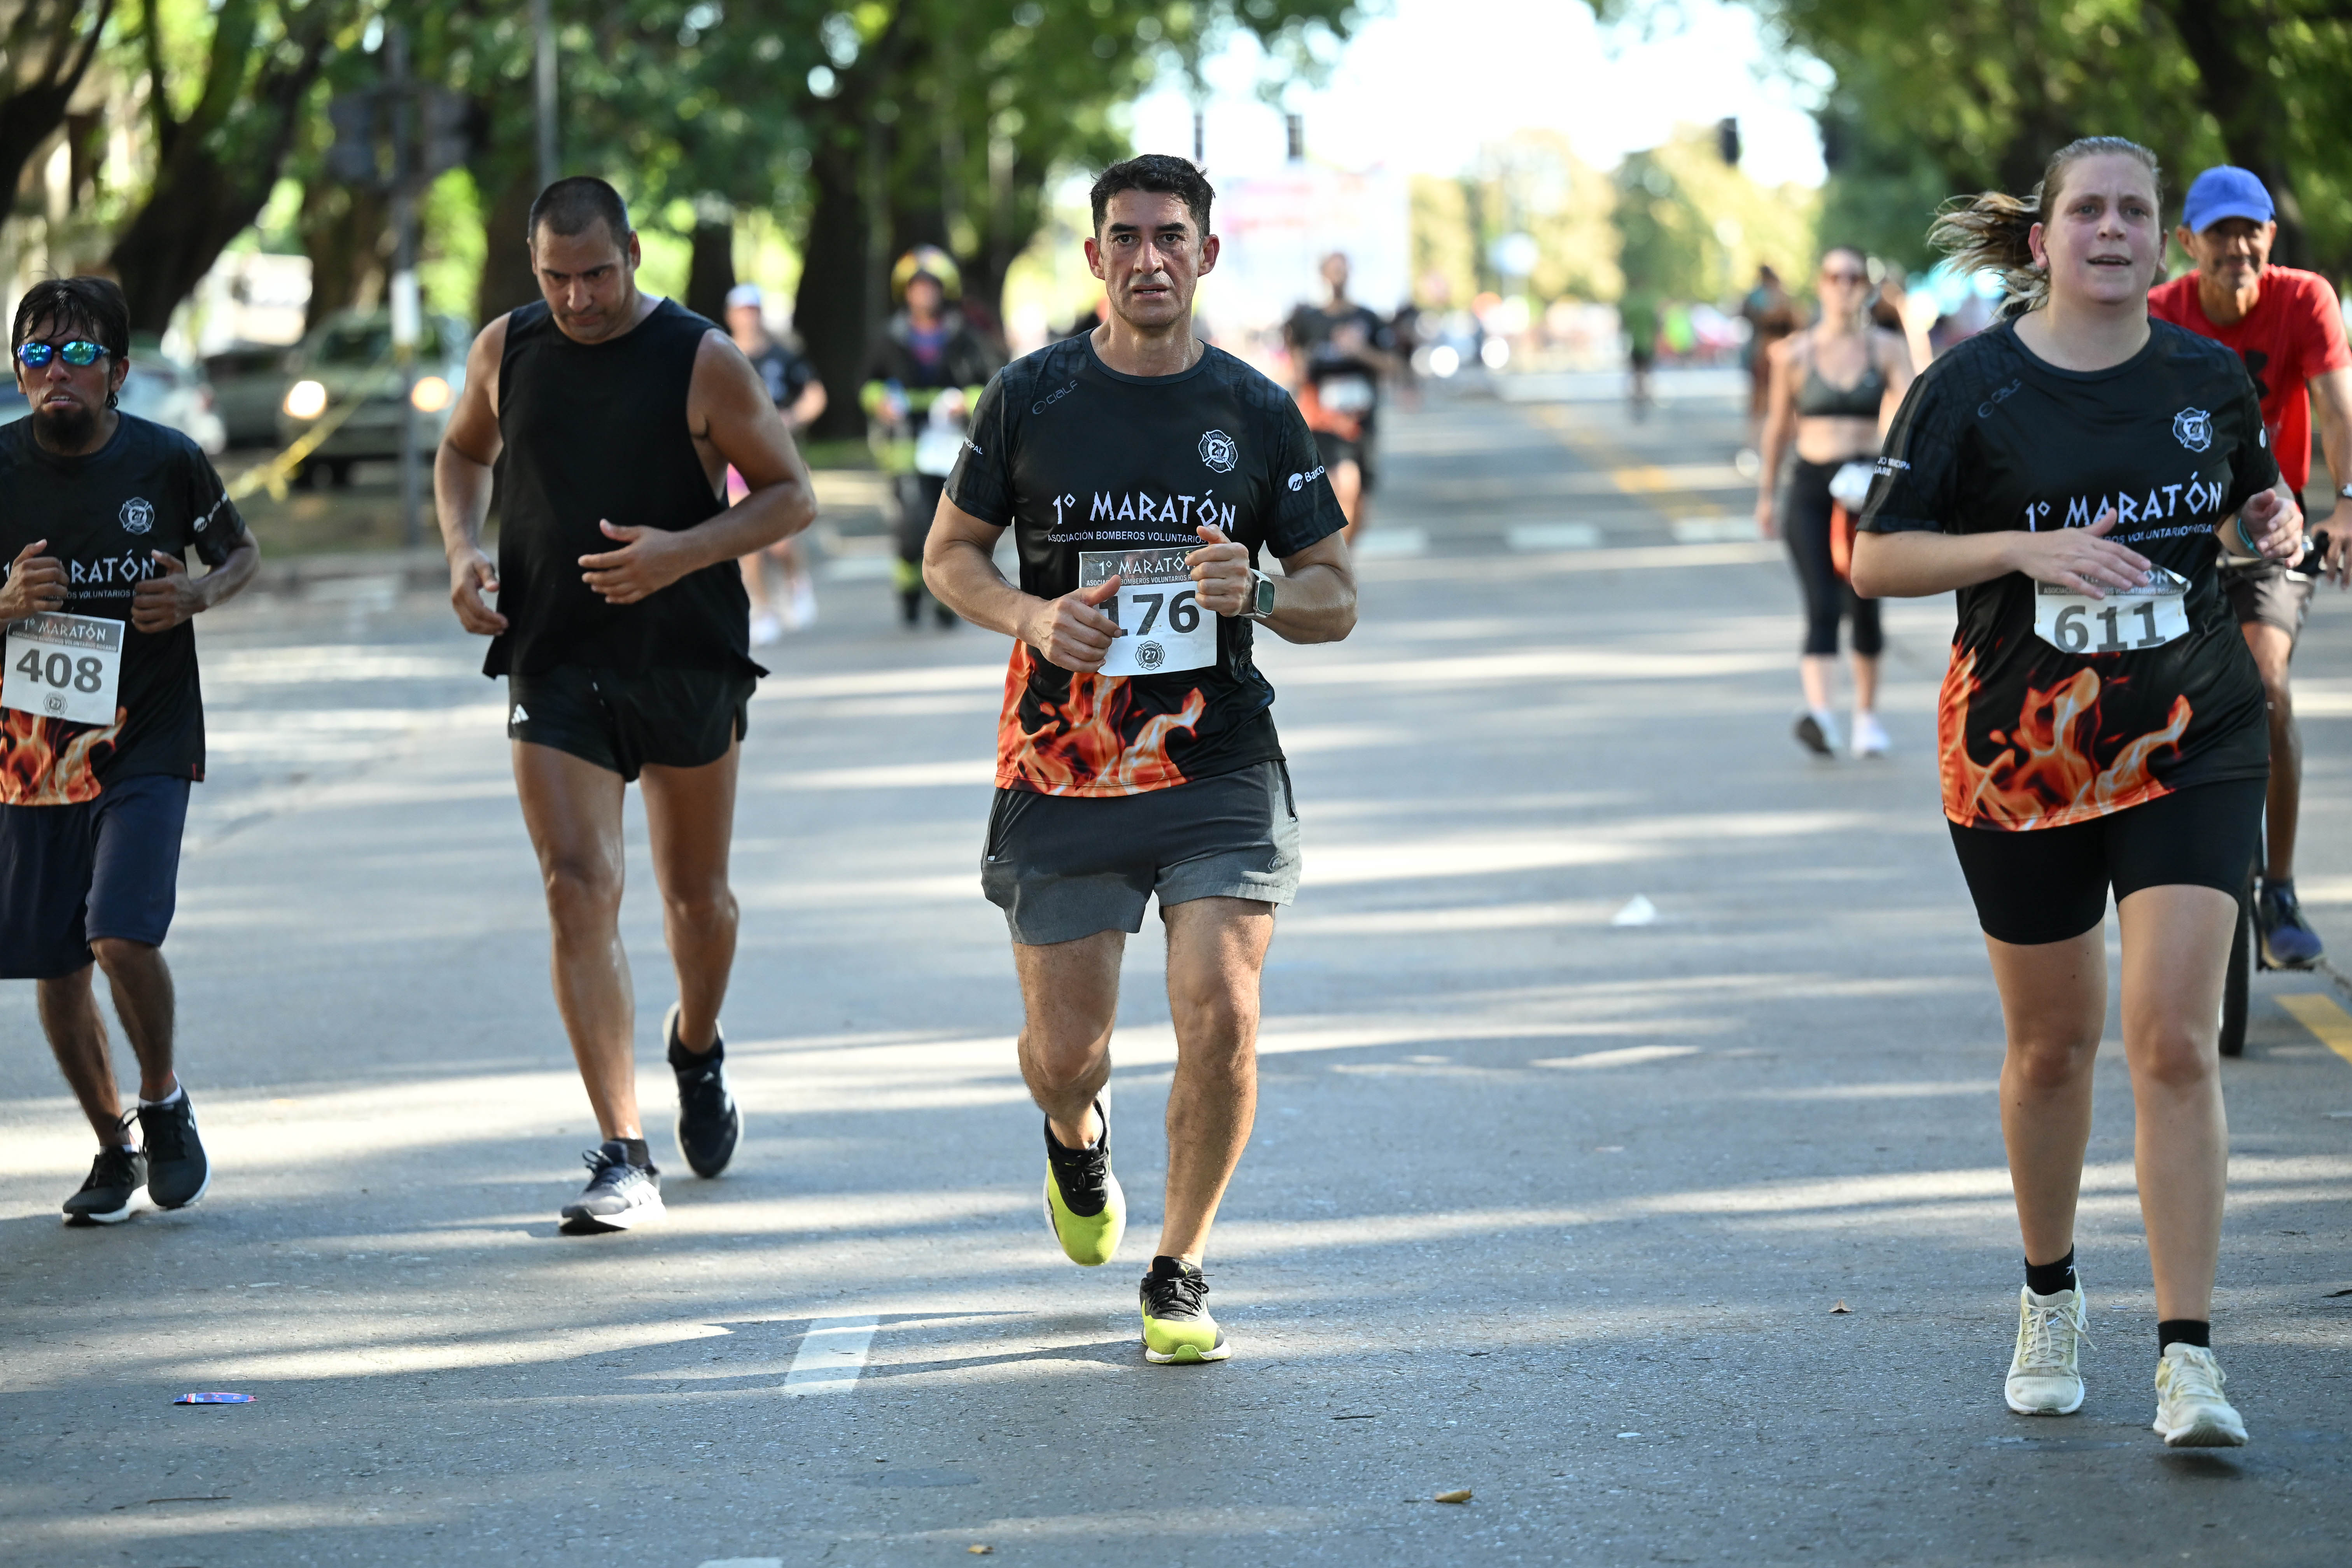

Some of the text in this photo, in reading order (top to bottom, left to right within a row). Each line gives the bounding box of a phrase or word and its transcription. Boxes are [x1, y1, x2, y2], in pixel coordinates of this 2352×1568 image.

[964, 436, 983, 455] NICIPAL
[1212, 442, 1226, 457] 27
[1874, 465, 1892, 476] SARIO
[2063, 471, 2222, 528] MARATÓN
[1090, 489, 1236, 533] MARATÓN
[1048, 530, 1093, 542] ASOCIACIÓN
[1096, 531, 1145, 540] BOMBEROS
[71, 549, 155, 583] RATÓN
[1151, 575, 1186, 583] VOLUNTARIOS
[79, 589, 130, 599] VOLUNTARIOS
[1099, 590, 1200, 637] 176
[38, 621, 106, 642] MARATÓN
[2054, 601, 2165, 653] 611
[1145, 650, 1156, 660] 27
[16, 648, 103, 693] 408
